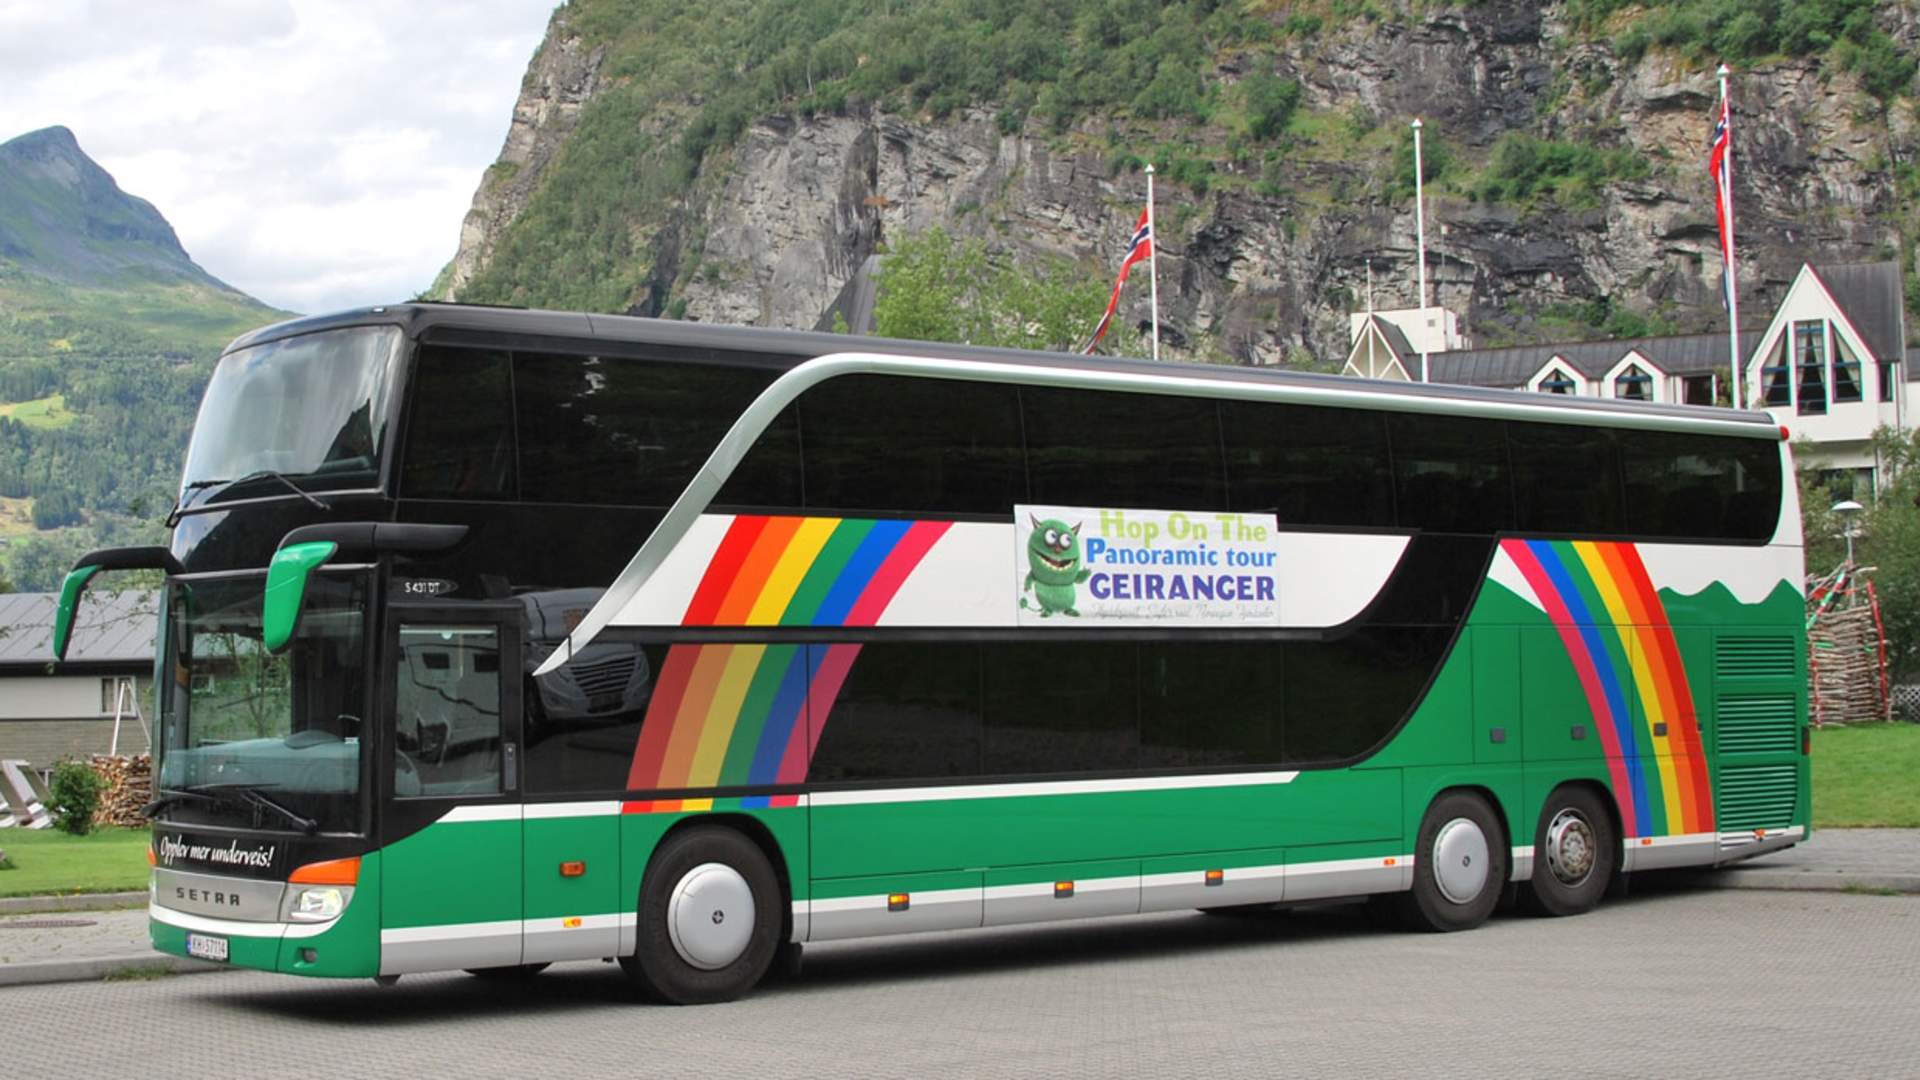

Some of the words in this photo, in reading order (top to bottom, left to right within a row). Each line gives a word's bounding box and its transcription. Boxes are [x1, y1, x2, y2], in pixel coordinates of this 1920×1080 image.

[1100, 510, 1159, 548] Hop
[1167, 512, 1208, 540] On
[1215, 514, 1268, 542] The
[1086, 538, 1218, 567] Panoramic
[1226, 547, 1277, 567] tour
[1089, 573, 1275, 601] GEIRANGER
[160, 834, 190, 866] Opplev
[190, 845, 211, 860] mer
[211, 839, 275, 868] underveis!
[176, 887, 241, 906] SETRA
